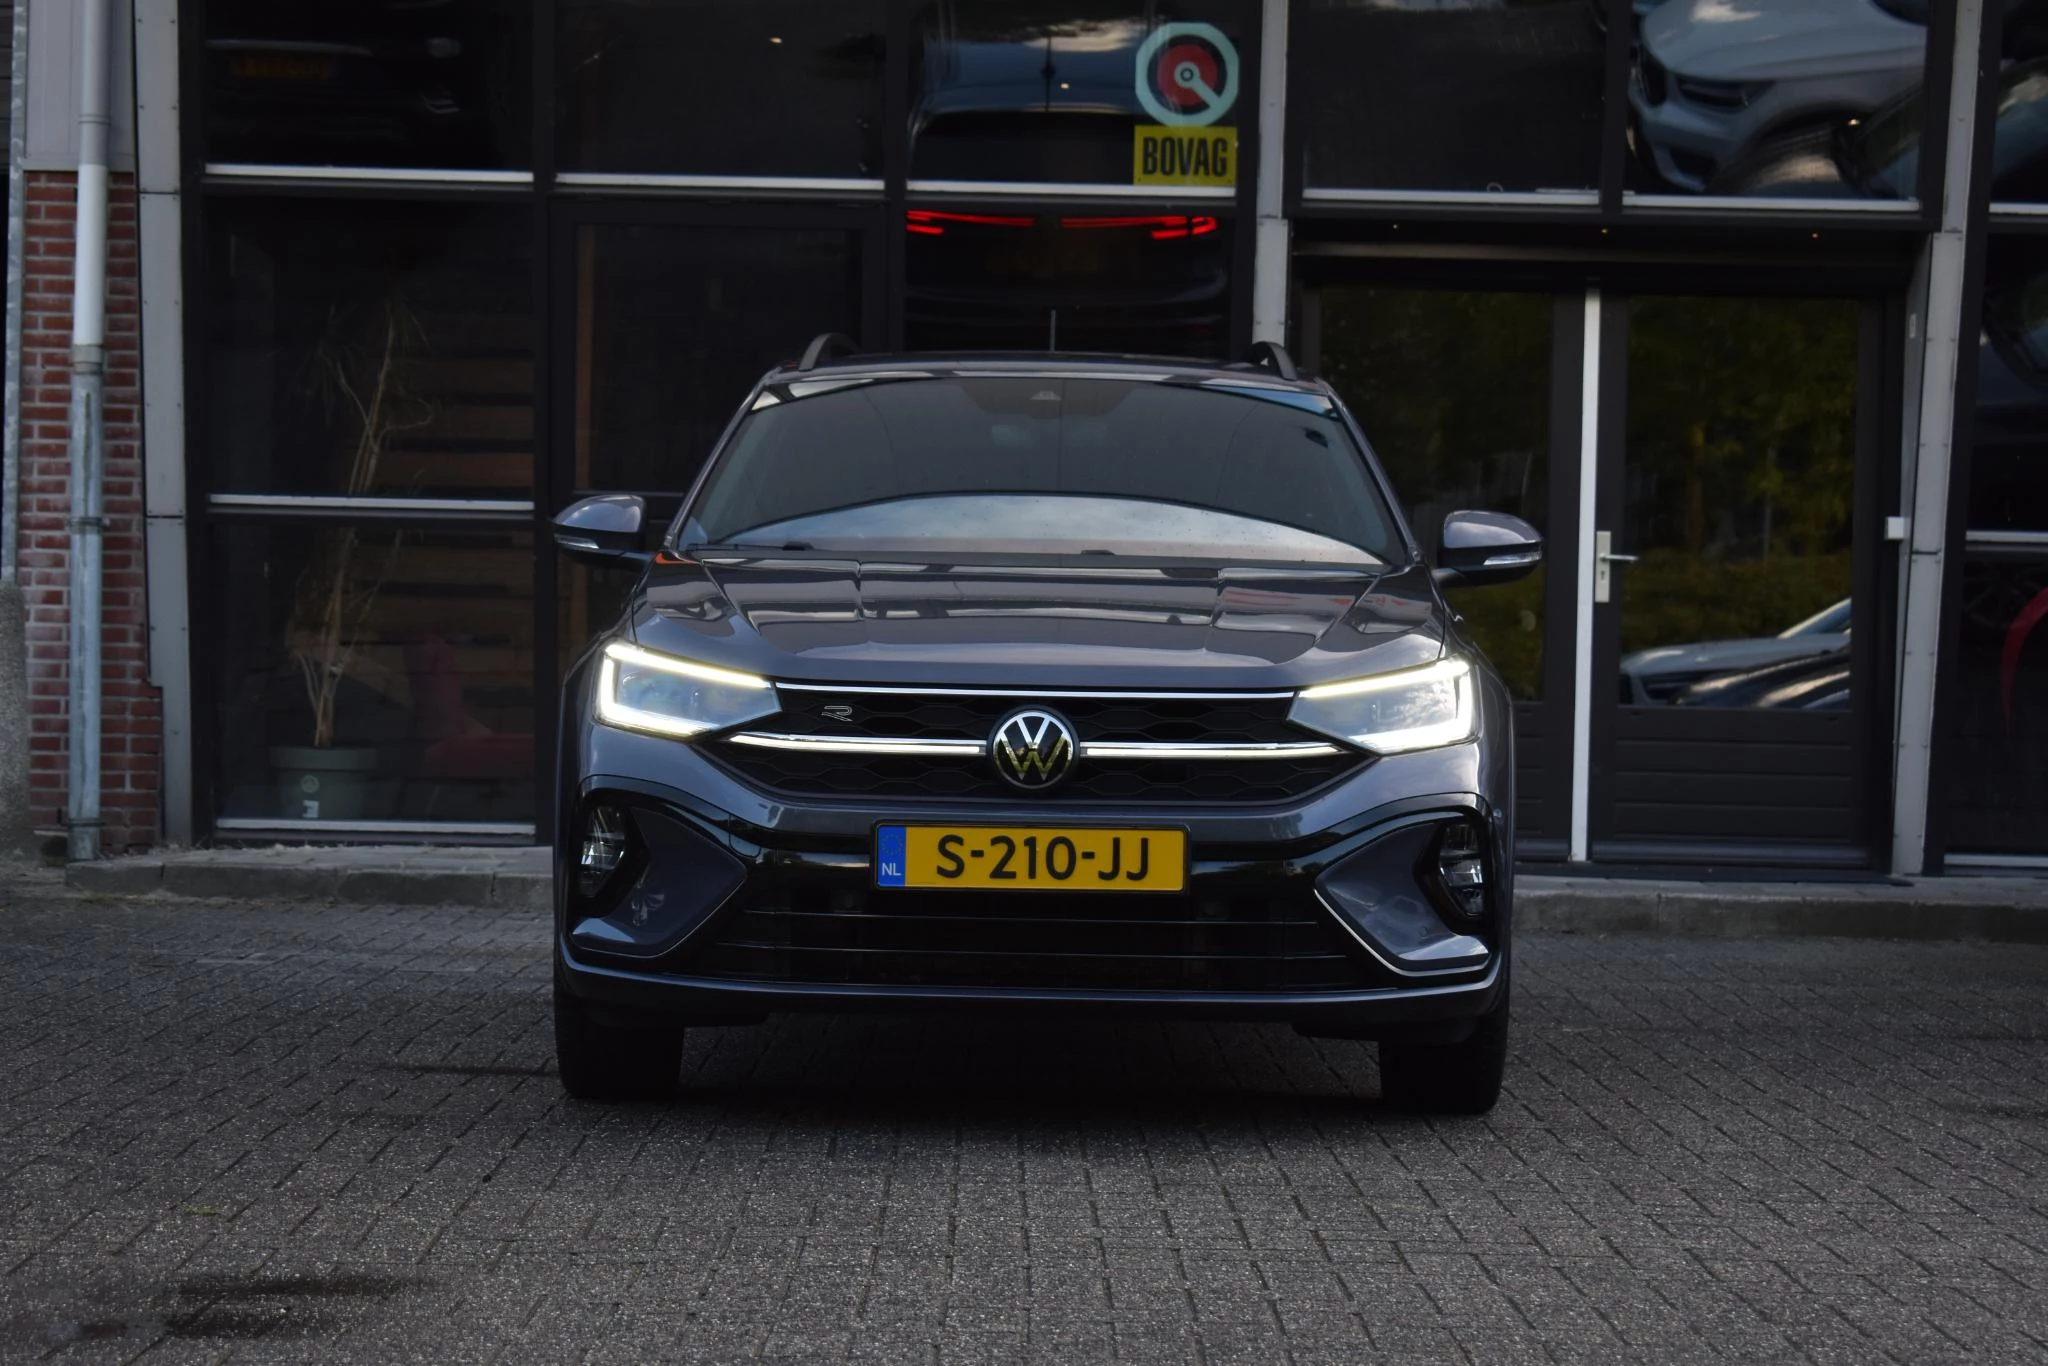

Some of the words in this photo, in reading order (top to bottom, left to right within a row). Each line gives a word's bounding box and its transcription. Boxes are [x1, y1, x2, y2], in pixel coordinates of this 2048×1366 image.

[1142, 136, 1228, 177] BOVAG
[881, 862, 902, 876] NL
[936, 834, 1150, 881] S-210-JJ
